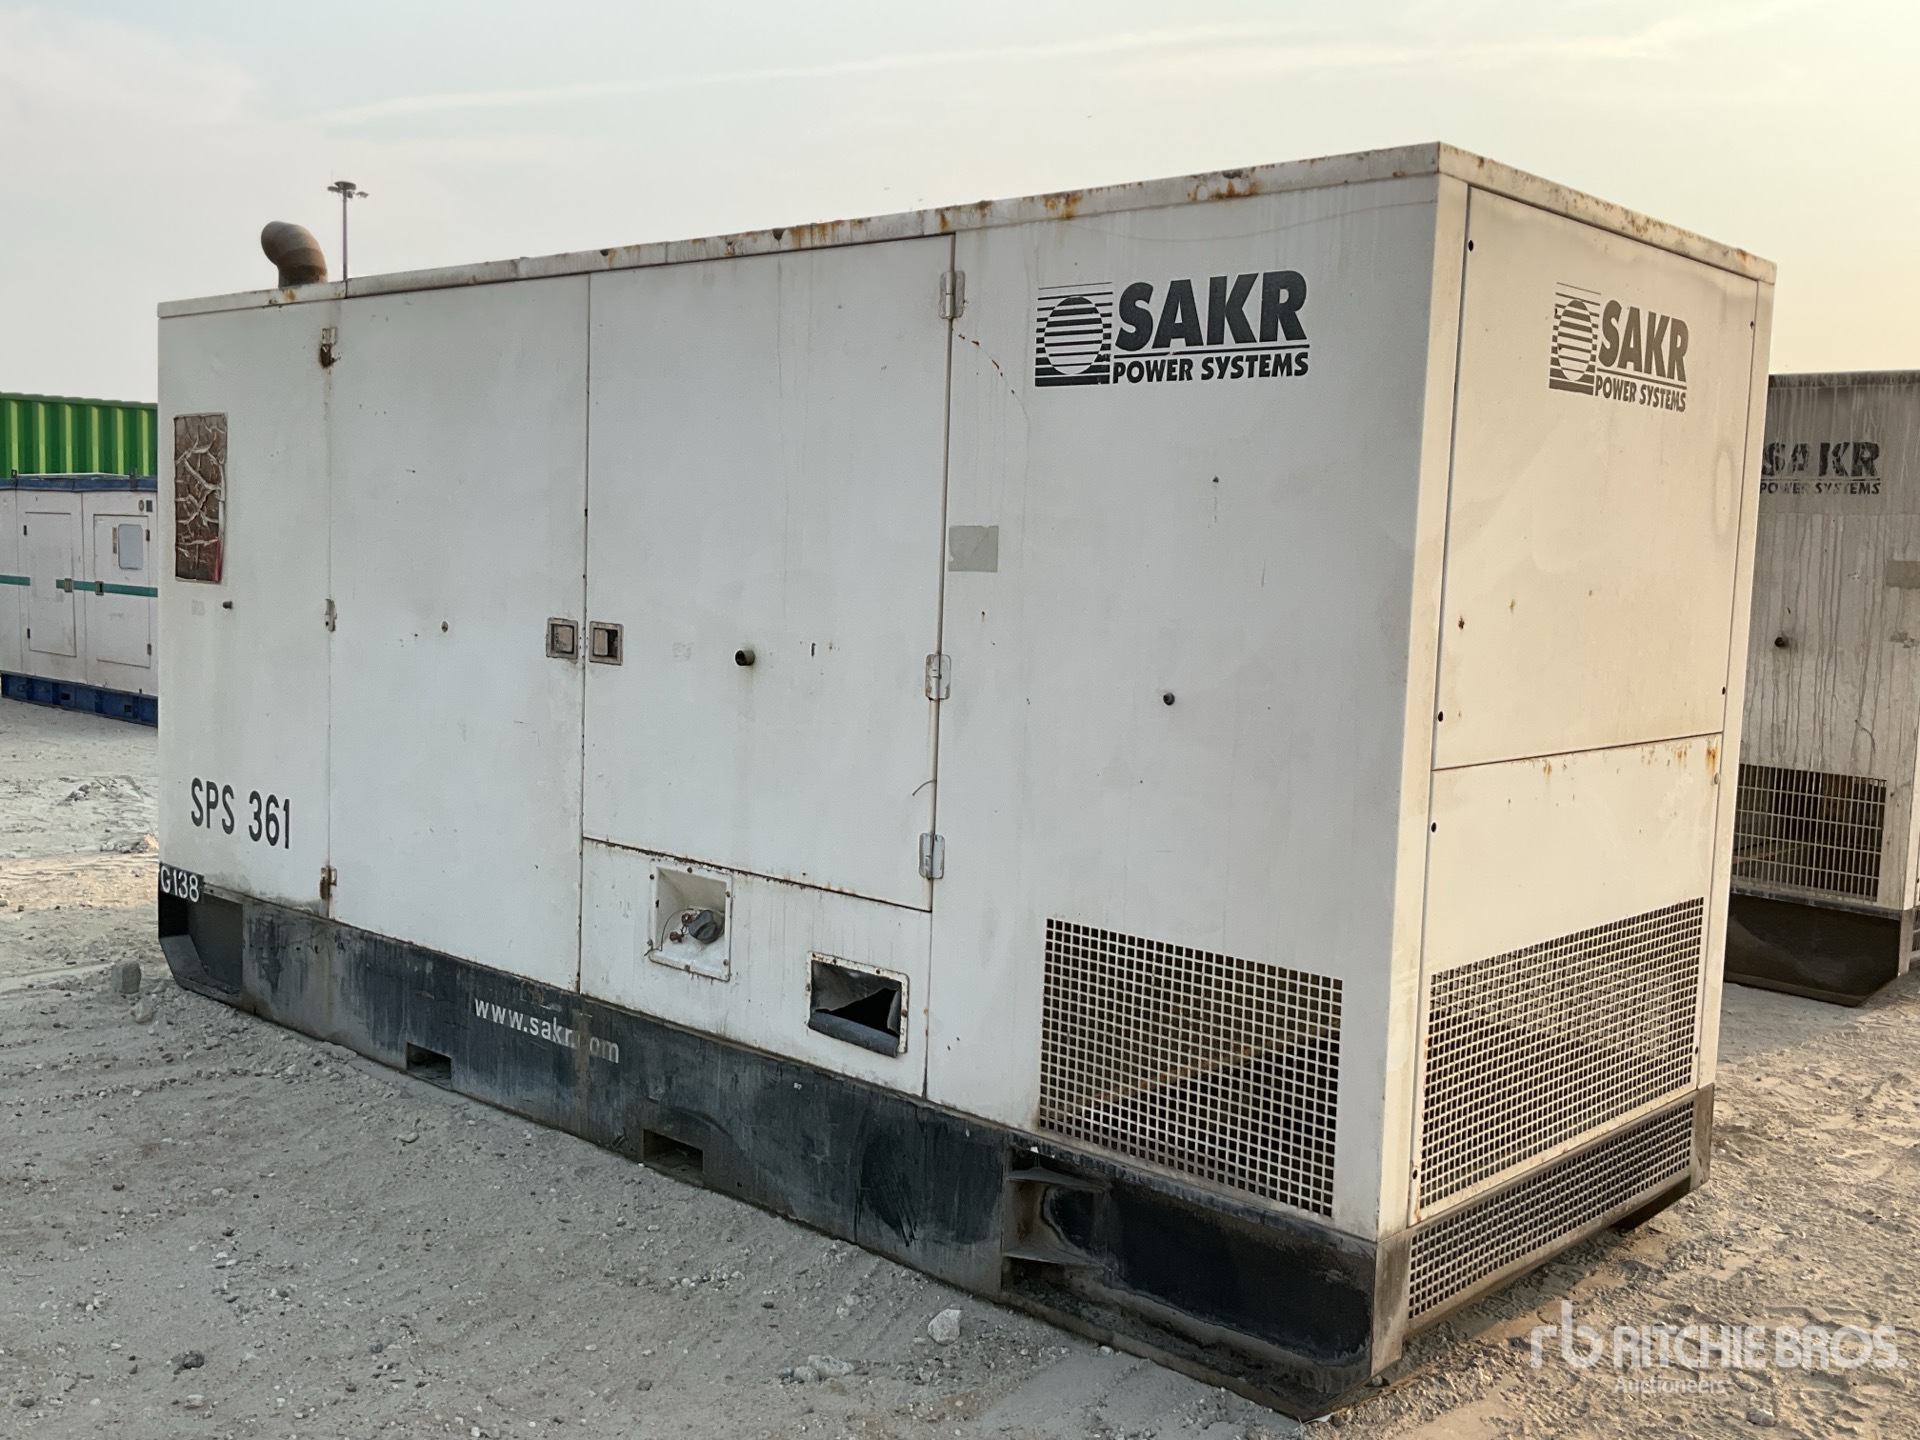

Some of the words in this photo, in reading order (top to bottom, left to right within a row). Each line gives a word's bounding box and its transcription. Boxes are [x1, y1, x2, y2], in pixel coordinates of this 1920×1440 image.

[1115, 270, 1308, 352] SAKR
[1598, 299, 1689, 382] SAKR
[1112, 358, 1194, 384] POWER
[1201, 351, 1309, 381] SYSTEMS
[1595, 374, 1637, 403] POWER
[1639, 384, 1686, 413] SYSTEMS
[1761, 441, 1880, 477] SAKR
[191, 777, 235, 835] SPS
[248, 790, 290, 849] 361
[160, 864, 200, 903] G138
[474, 997, 620, 1064] www.sakr.om
